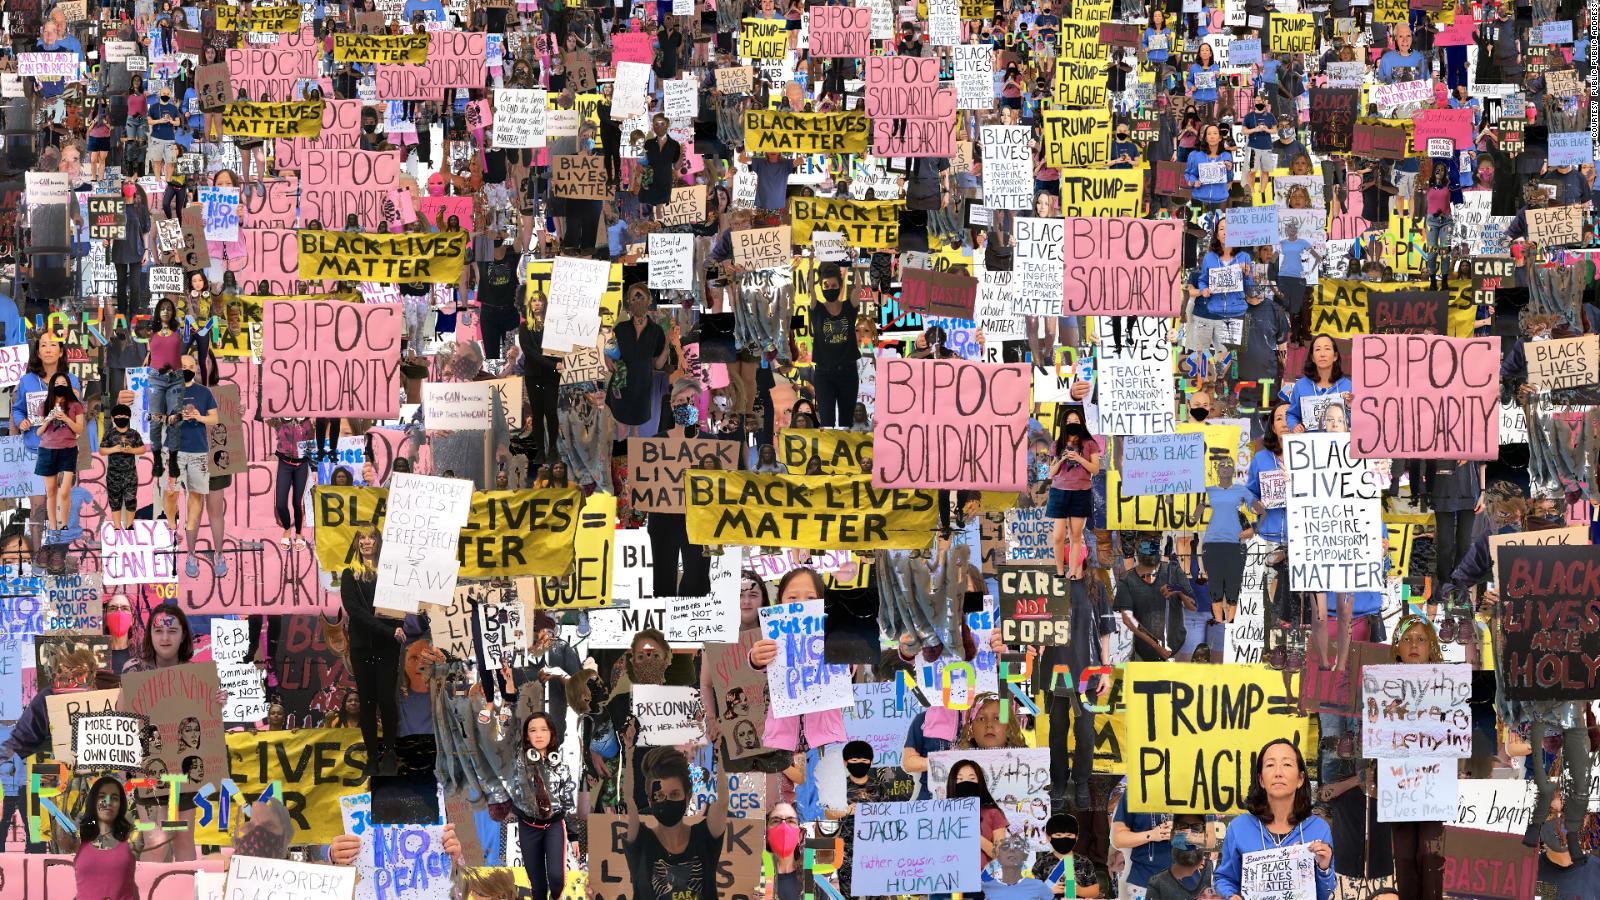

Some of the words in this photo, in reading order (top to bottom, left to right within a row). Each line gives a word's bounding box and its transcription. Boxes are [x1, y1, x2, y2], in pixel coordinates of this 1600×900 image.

[813, 7, 869, 28] BIPOC
[930, 6, 957, 15] LIVES
[336, 37, 381, 48] BLACK
[385, 38, 427, 48] LIVES
[812, 31, 871, 56] SOLIDARITY
[930, 36, 960, 45] MATTER
[344, 48, 409, 60] MATTER
[954, 47, 992, 60] BLACK
[1528, 48, 1549, 56] CARE
[231, 51, 294, 75] BIPOC
[870, 58, 936, 83] BIPOC
[956, 61, 991, 71] LIVES
[720, 70, 746, 80] BLACK
[722, 78, 747, 88] LIVES
[1059, 82, 1107, 104] PLAGUE!
[867, 87, 939, 118] SOLIDARITY
[957, 98, 992, 108] MATTER
[269, 105, 321, 120] LIVES
[1131, 111, 1159, 121] CARE
[222, 120, 299, 134] MATTER
[747, 113, 806, 131] BLACK
[813, 115, 866, 132] LIVES
[758, 132, 845, 149] MATTER
[984, 128, 1031, 145] BLACK
[1131, 130, 1159, 141] COPS
[985, 145, 1031, 160] LIVES
[1051, 141, 1109, 165] PLAGUE!
[307, 152, 394, 186] BIPOC
[990, 163, 1019, 171] TEACH
[557, 170, 607, 182] LIVES
[991, 171, 1021, 179] INSPIRE
[555, 182, 616, 195] MATTER
[90, 201, 124, 213] CARE
[208, 200, 232, 217] NO
[662, 202, 697, 216] LIVES
[984, 194, 1033, 209] MATTER
[795, 201, 872, 220] BLACK
[1535, 209, 1572, 225] BLACK
[96, 215, 115, 225] NOT
[90, 225, 126, 239] COPS
[1537, 222, 1574, 236] LIVES
[302, 230, 381, 255] BLACK
[391, 236, 462, 257] LIVES
[741, 232, 779, 246] BLACK
[1073, 217, 1176, 260] BIPOC
[744, 244, 782, 259] LIVES
[318, 255, 431, 277] MATTER
[742, 255, 787, 271] MATTER
[1023, 262, 1055, 272] TEACH
[1475, 261, 1514, 276] CARE
[166, 283, 180, 291] GUNS
[1068, 265, 1181, 312] SOLIDARITY
[1376, 300, 1438, 327] BLACK
[272, 301, 394, 352] BIPOC
[1536, 342, 1585, 362] BLACK
[1362, 336, 1491, 389] BIPOC
[1540, 360, 1587, 373] LIVES
[1110, 365, 1151, 376] TEACH
[268, 356, 400, 414] SOLIDARITY
[887, 360, 1022, 416] BIPOC
[1111, 377, 1156, 388] INSPIRE
[1541, 373, 1595, 389] MATTER
[1111, 389, 1163, 399] TRANSFORM
[1101, 412, 1174, 434] MATTER
[1358, 396, 1500, 454] SOLIDARITY
[881, 423, 1028, 483] SOLIDARITY
[1164, 445, 1199, 460] BLAKE
[691, 476, 813, 508] BLACK
[1145, 479, 1191, 493] HUMAN
[1291, 472, 1376, 499] LIVES
[1016, 508, 1042, 521] WHO
[1303, 505, 1353, 518] TEACH
[391, 511, 439, 529] CODE
[713, 509, 888, 543] MATTER
[1305, 519, 1360, 534] INSPIRE
[1017, 534, 1048, 546] YOUR
[1304, 534, 1368, 547] TRANSFORM
[1011, 547, 1055, 560] DREAMS
[1306, 548, 1363, 561] EMPOWER
[105, 552, 147, 579] CAN
[54, 575, 81, 588] WHO
[394, 565, 452, 590] LAW
[712, 570, 731, 580] with
[1292, 562, 1382, 589] MATTER
[1002, 571, 1065, 596] CARE
[50, 589, 97, 601] POLICES
[56, 603, 87, 615] YOUR
[692, 610, 712, 618] NOT
[1015, 598, 1052, 617] NOT
[50, 616, 98, 630] DREAMS
[1504, 600, 1599, 633] LIVES
[1003, 620, 1070, 645] COPS
[1509, 652, 1600, 689] HOLY
[240, 688, 260, 696] NOT
[866, 684, 892, 694] LIVES
[636, 700, 702, 717] BREONNA
[84, 719, 113, 732] MORE
[116, 719, 137, 733] POC
[658, 723, 674, 731] HER
[86, 733, 134, 746] SHOULD
[83, 750, 108, 764] OWN
[110, 749, 137, 764] GUNS
[900, 800, 928, 814] LIVES
[933, 798, 977, 812] MATTER
[857, 819, 908, 843] JACOB
[918, 816, 973, 840] BLAKE
[1262, 861, 1292, 873] BLACK
[1443, 856, 1515, 892] BASTA
[887, 870, 959, 892] HUMAN
